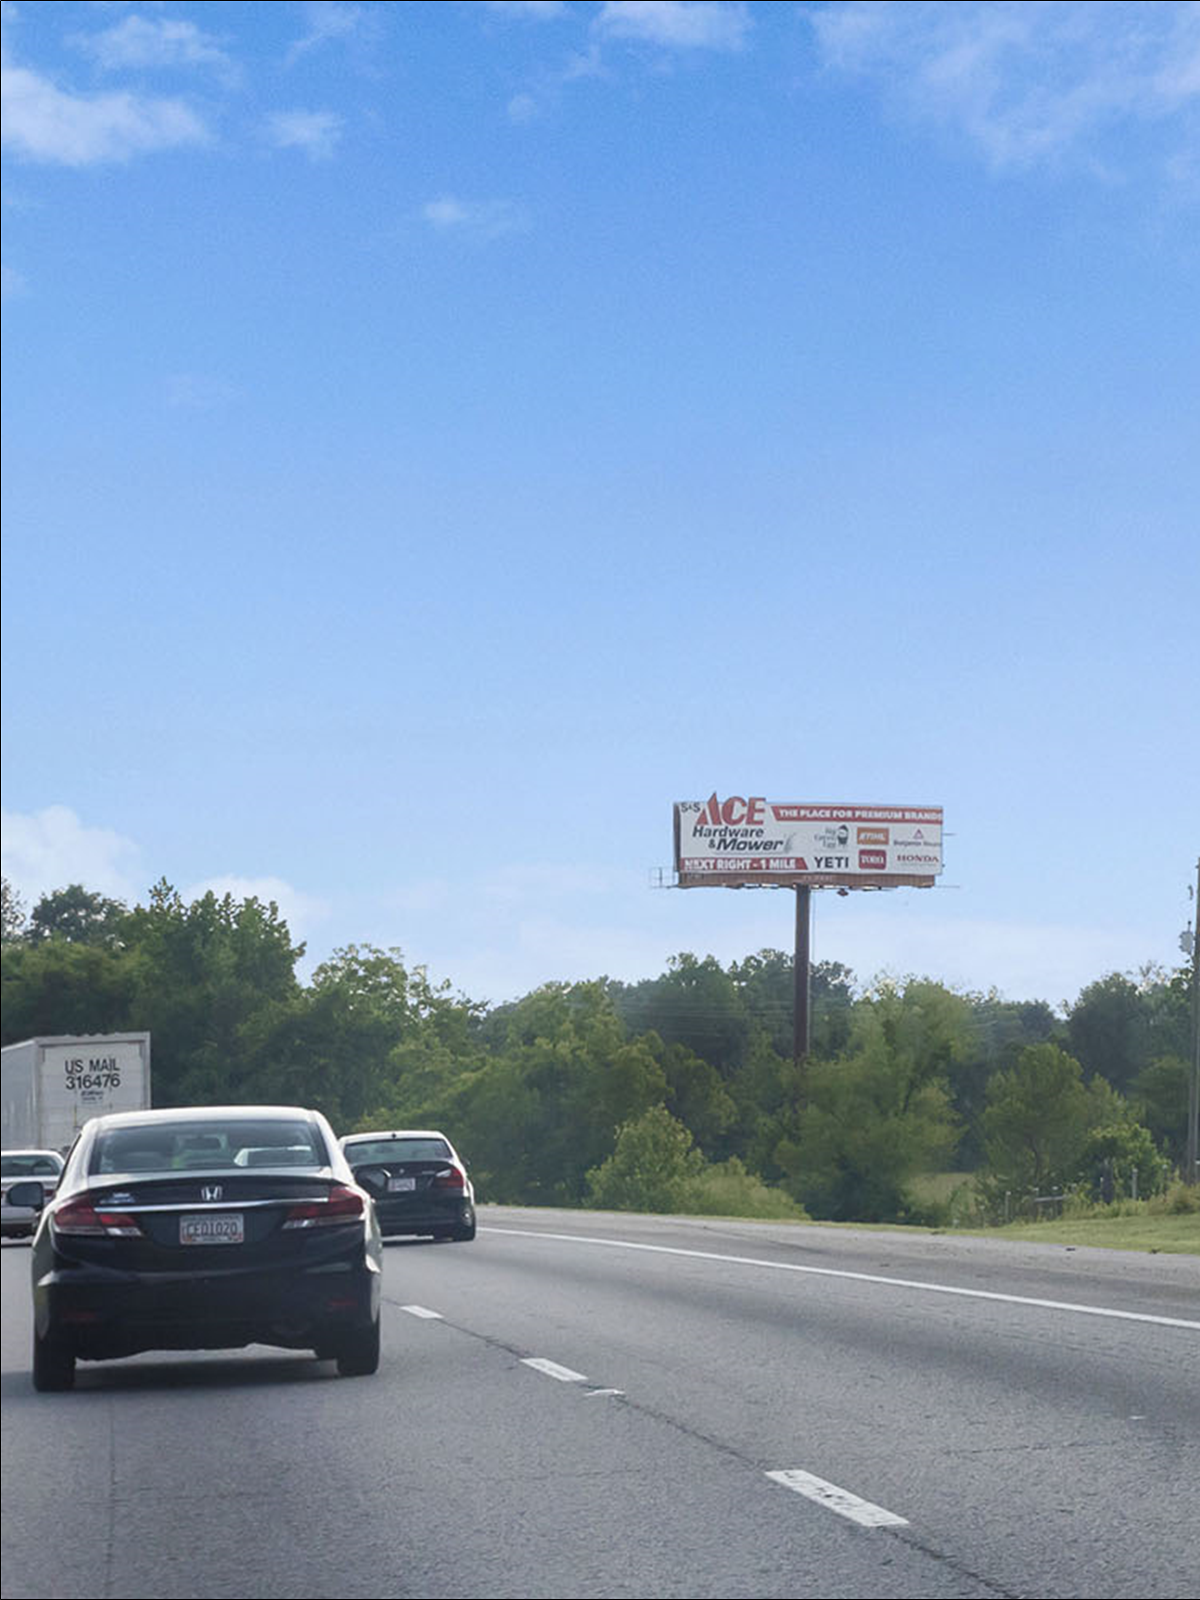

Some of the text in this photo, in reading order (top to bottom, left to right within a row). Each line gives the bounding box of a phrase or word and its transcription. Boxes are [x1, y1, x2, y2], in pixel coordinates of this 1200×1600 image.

[696, 792, 766, 826] ACE
[780, 808, 798, 818] THE
[799, 808, 831, 818] PLACE
[832, 809, 852, 819] FOR
[854, 810, 901, 820] PREMIUM
[692, 826, 764, 838] Hardware
[708, 838, 784, 851] & Mower
[685, 859, 715, 869] NEXT
[717, 859, 752, 869] RIGHT
[760, 859, 767, 869] 1
[769, 859, 796, 870] MILE
[814, 857, 849, 869] YETI
[897, 855, 939, 863] HONDA
[65, 1058, 121, 1074] US MAIL
[66, 1073, 121, 1090] 316476
